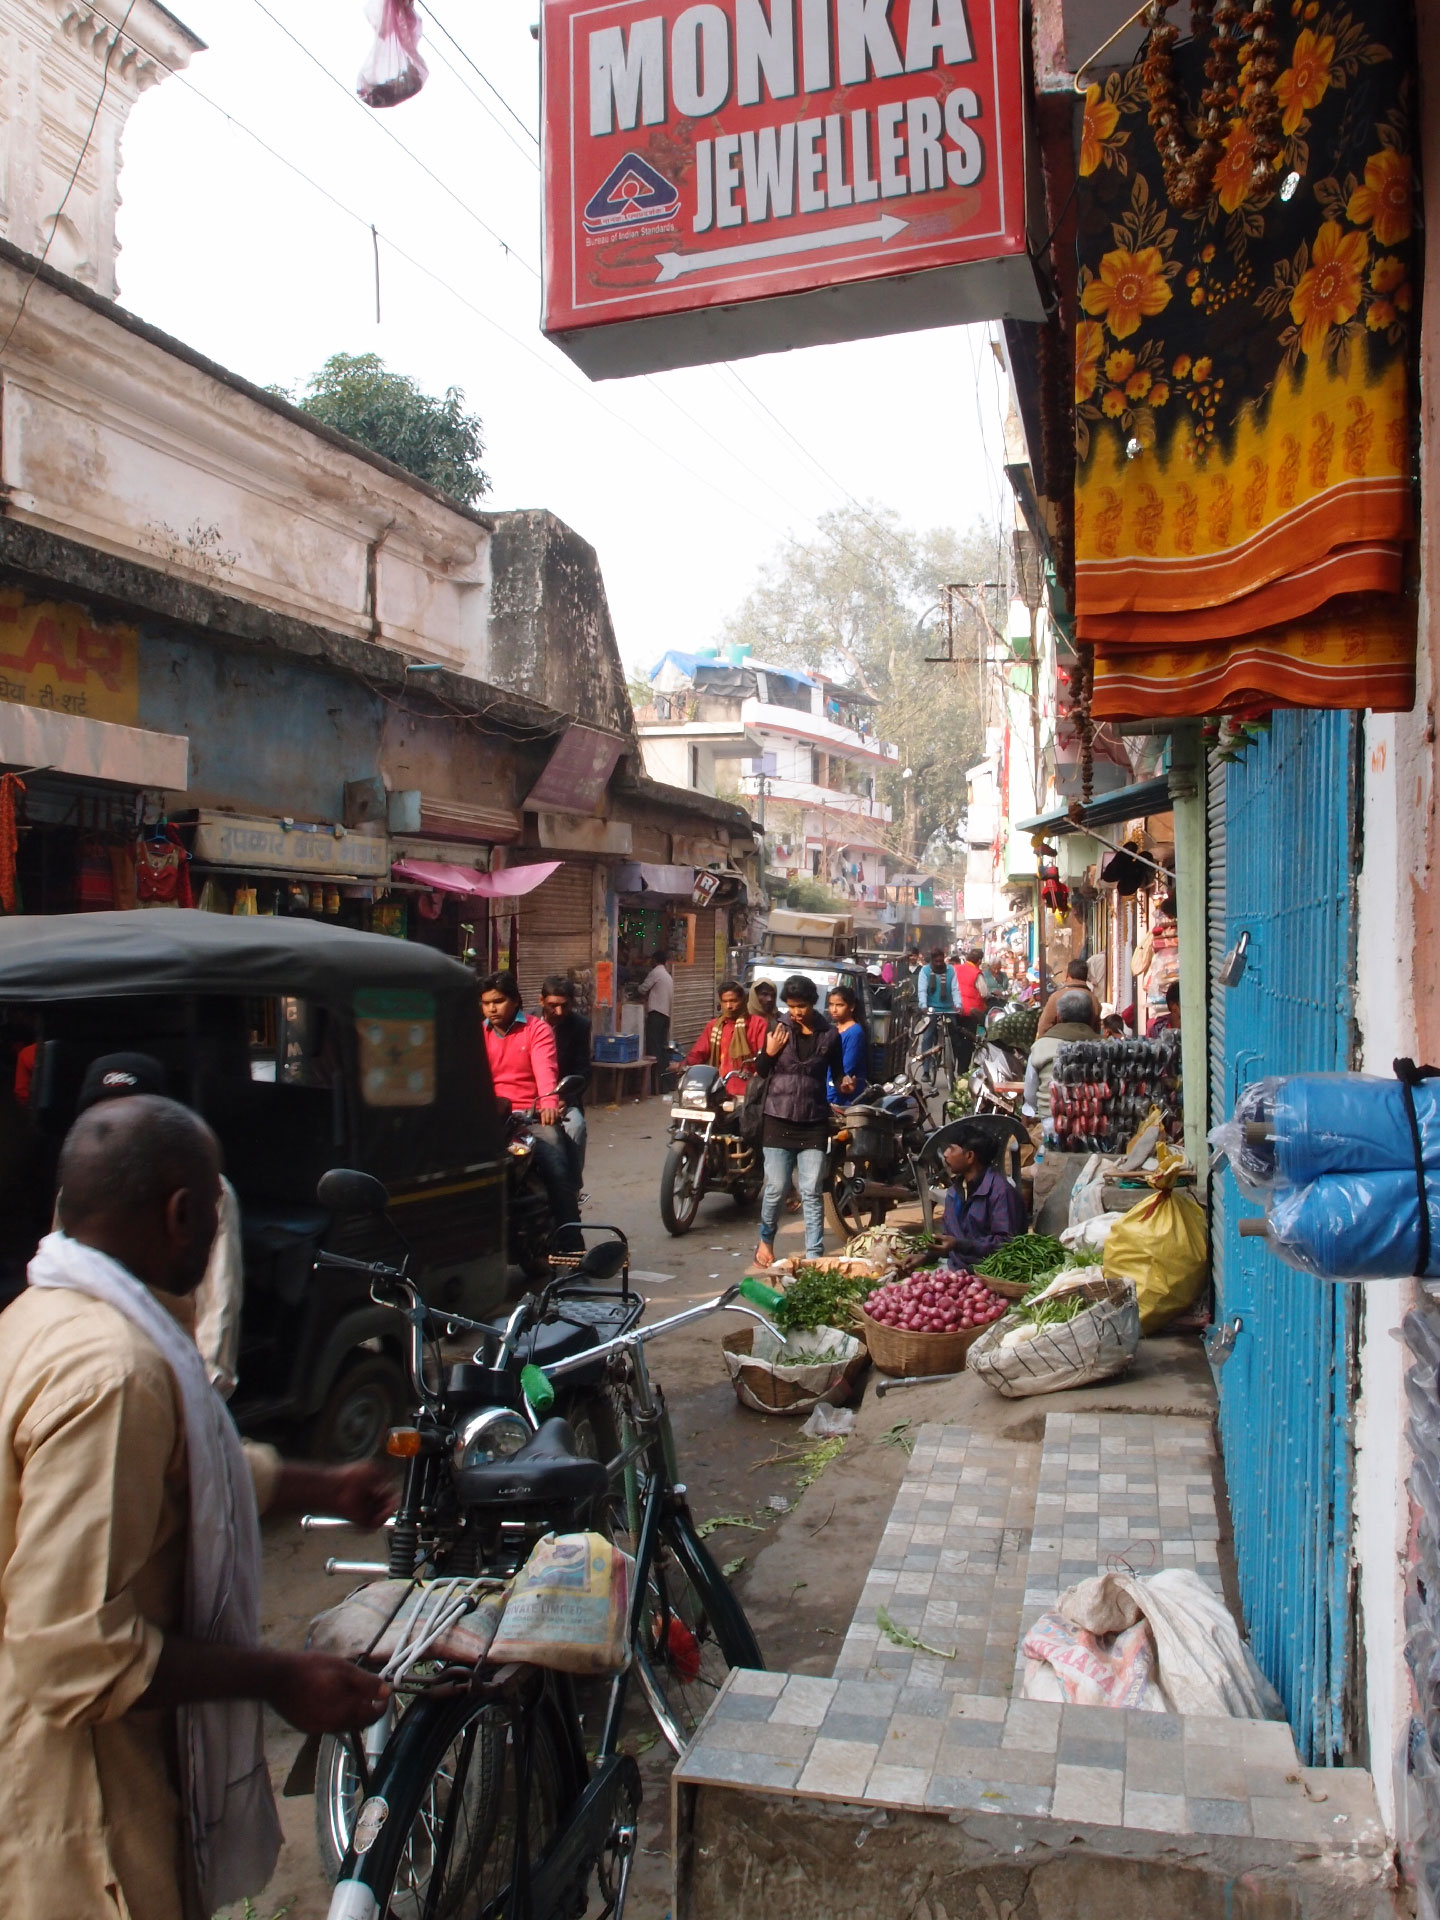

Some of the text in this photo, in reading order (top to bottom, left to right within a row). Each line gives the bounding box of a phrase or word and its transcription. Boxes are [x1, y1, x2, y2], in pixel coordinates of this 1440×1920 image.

[588, 0, 973, 137] MONIKA
[692, 87, 983, 233] JEWELLERS
[585, 223, 675, 247] Bureau of Indian Standards
[541, 1602, 583, 1616] LIMITED
[1055, 1647, 1117, 1697] AATA
